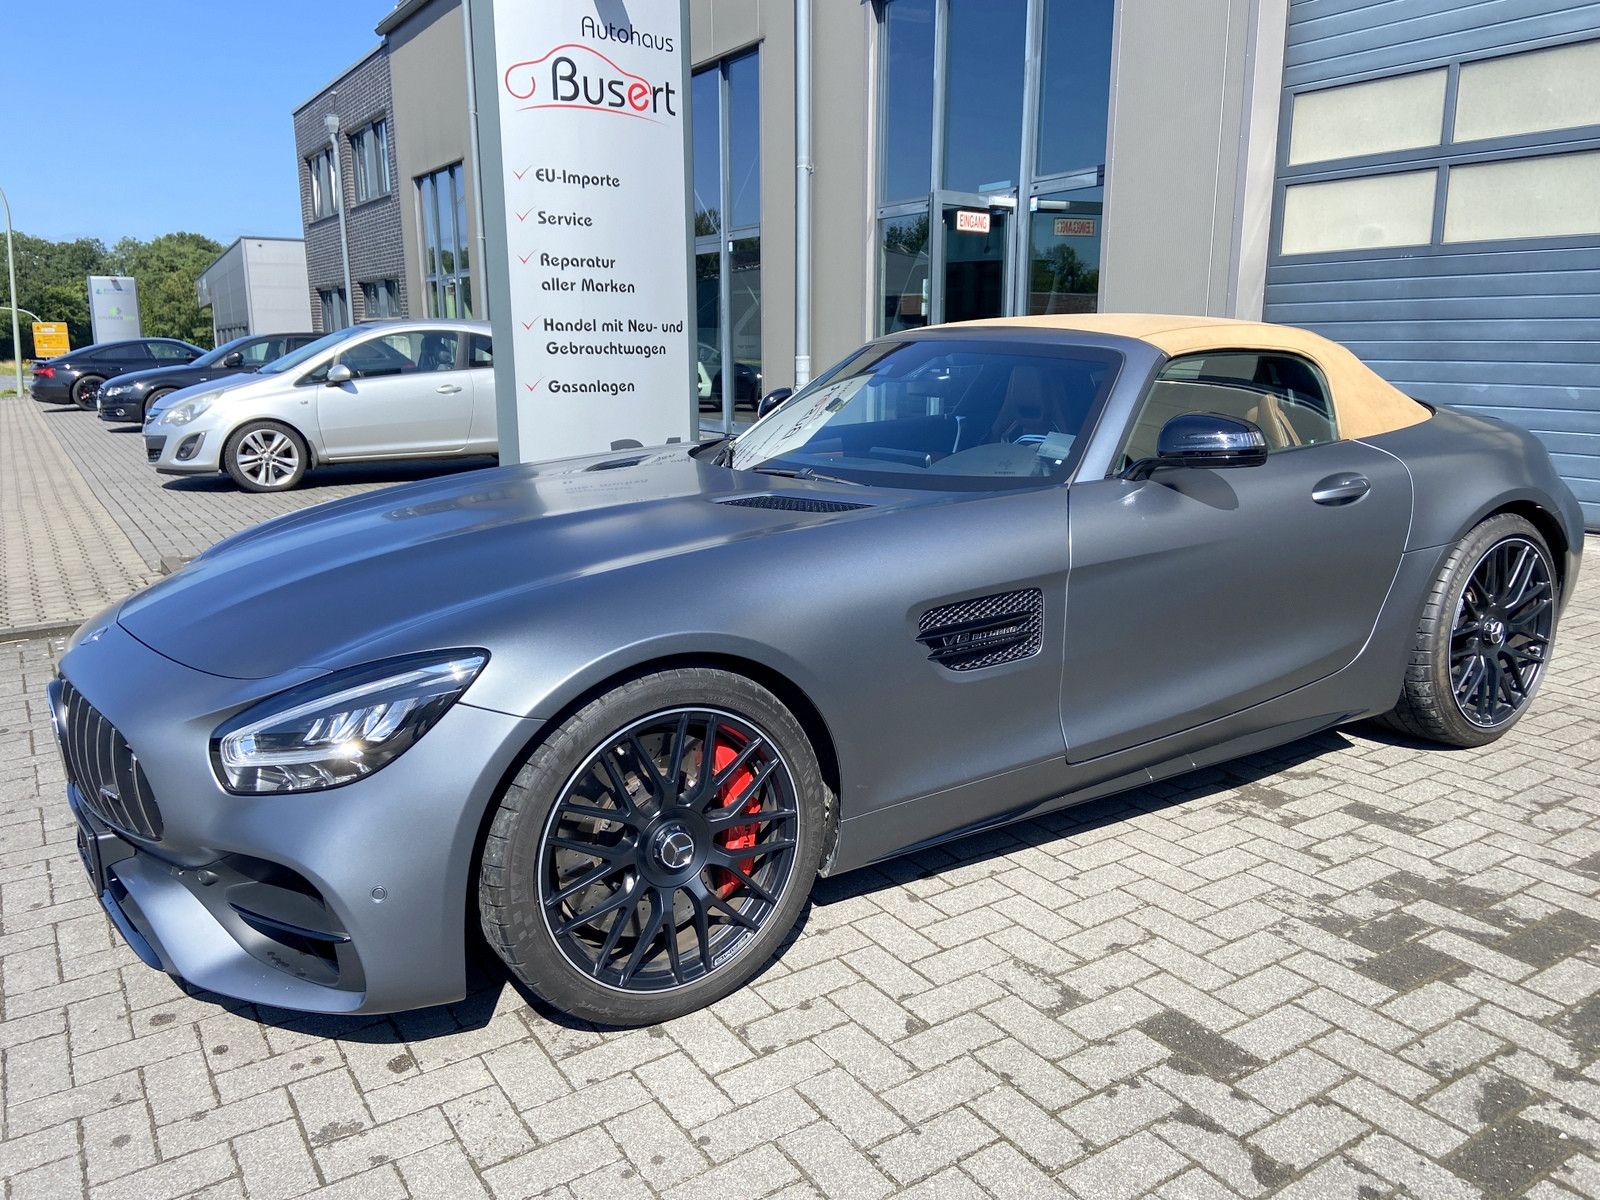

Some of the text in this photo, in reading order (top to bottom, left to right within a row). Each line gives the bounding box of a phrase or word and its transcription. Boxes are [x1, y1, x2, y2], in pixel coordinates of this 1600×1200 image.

[581, 16, 674, 52] Autohaus
[551, 56, 676, 116] Busert
[535, 168, 621, 188] EU-Importe
[538, 211, 593, 227] Service
[959, 213, 988, 230] EINGANG
[540, 253, 616, 270] Reparatur
[541, 278, 635, 293] aller Marken
[543, 318, 683, 333] Handel mit Neu- und
[546, 341, 666, 358] Gebrauchtwagen
[548, 380, 635, 396] Gasanlagen
